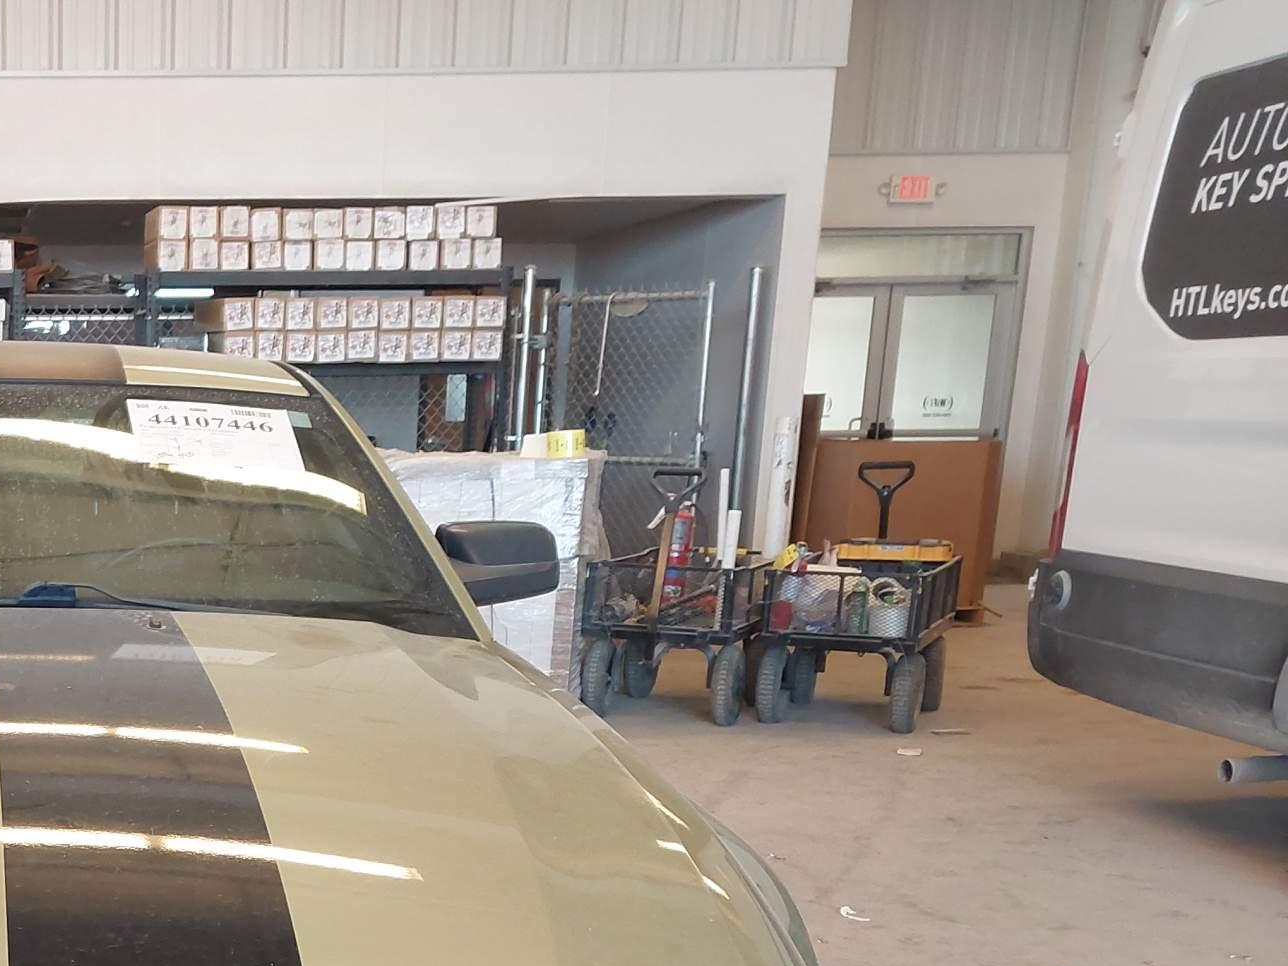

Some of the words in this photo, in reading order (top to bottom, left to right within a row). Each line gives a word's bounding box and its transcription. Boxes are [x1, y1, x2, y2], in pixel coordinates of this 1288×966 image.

[1190, 168, 1251, 214] KEY
[1249, 160, 1288, 203] SP
[147, 413, 274, 433] 44107446
